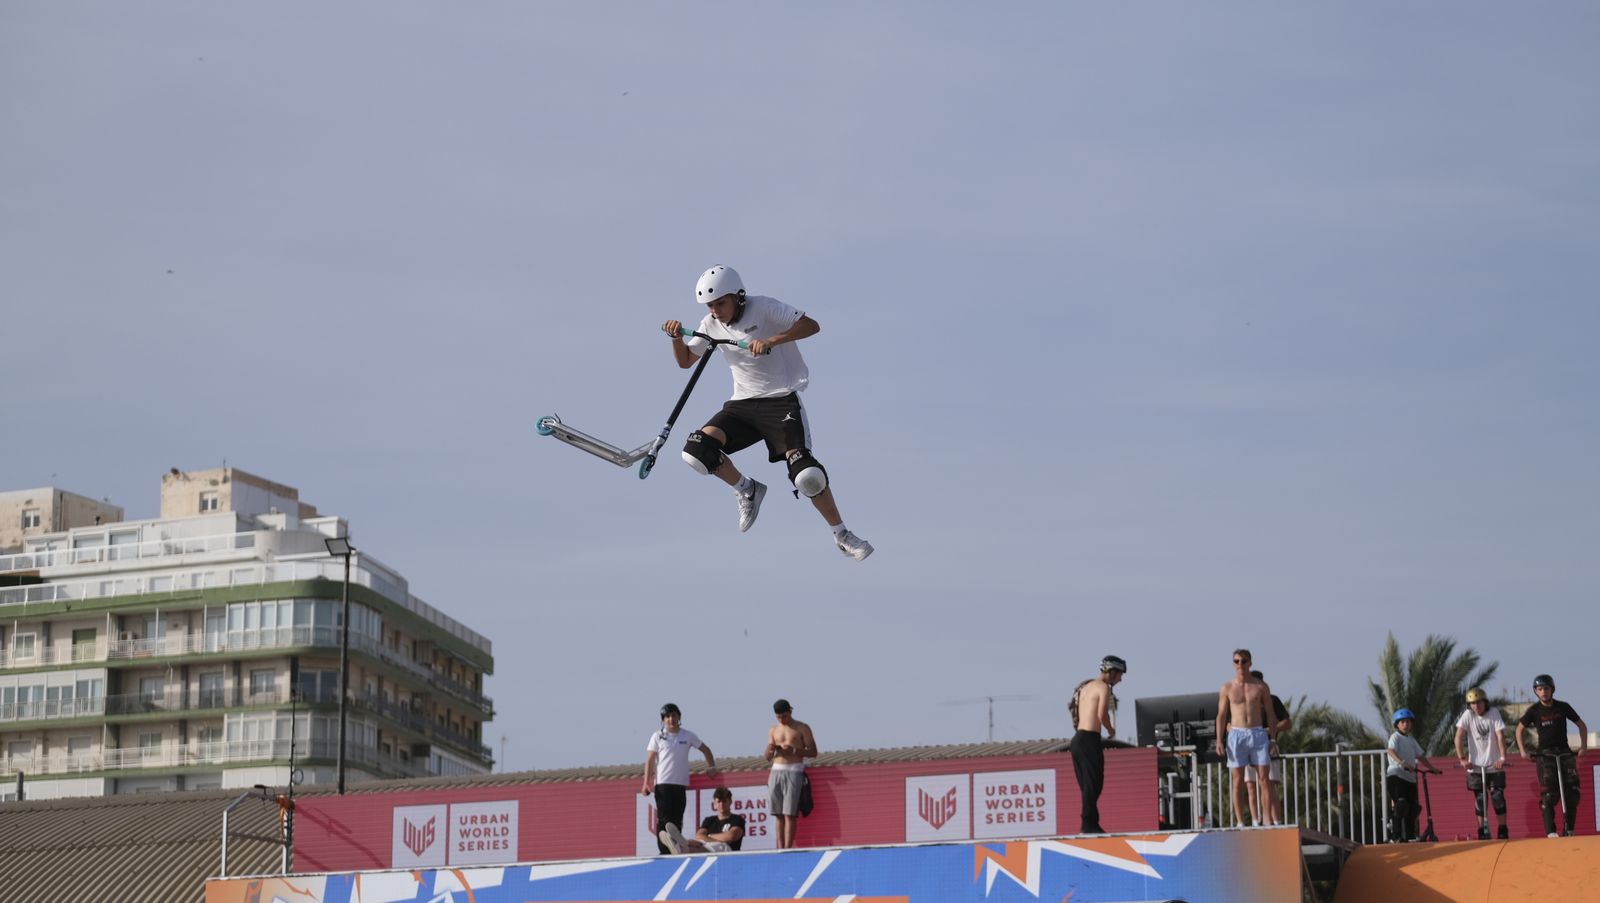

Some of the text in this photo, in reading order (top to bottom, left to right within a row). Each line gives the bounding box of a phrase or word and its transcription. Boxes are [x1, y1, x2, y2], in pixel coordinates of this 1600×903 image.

[985, 783, 1045, 797] URBAN
[711, 799, 766, 811] UBAN
[985, 797, 1046, 810] WORLD
[459, 813, 509, 826] URBAN
[985, 810, 1046, 824] SERIES
[459, 826, 509, 839] WORLD
[458, 839, 509, 852] SERIES
